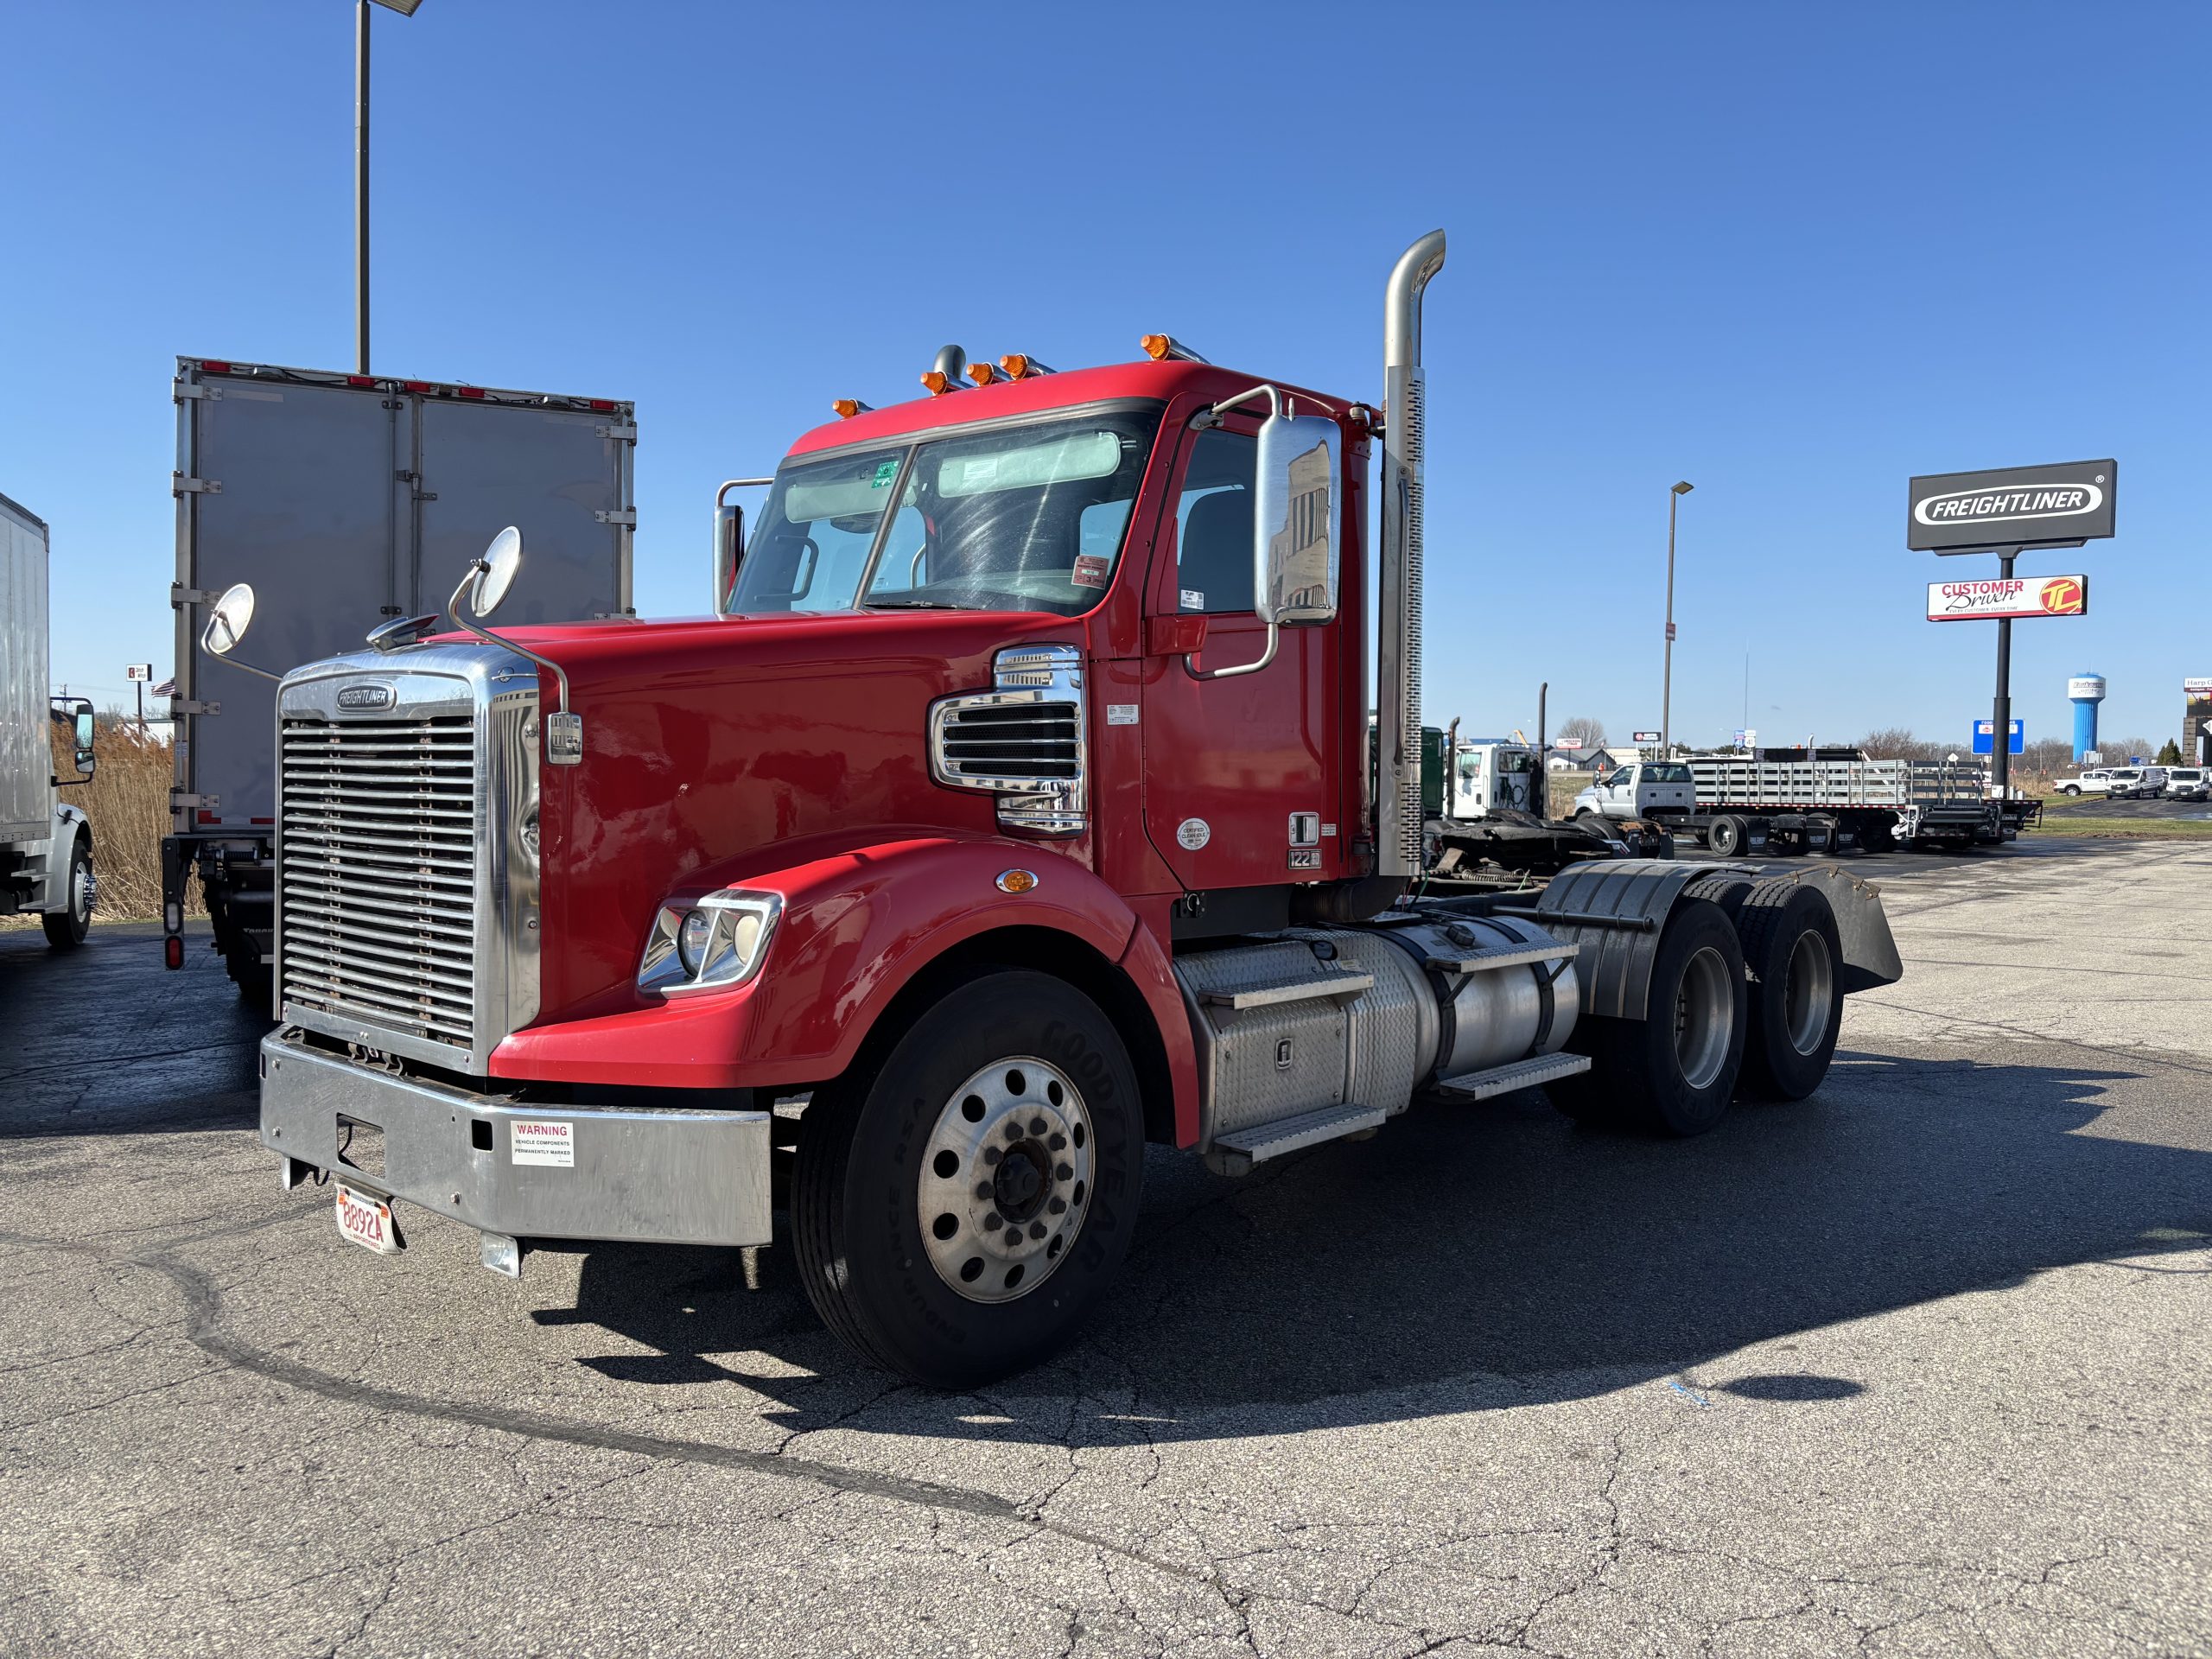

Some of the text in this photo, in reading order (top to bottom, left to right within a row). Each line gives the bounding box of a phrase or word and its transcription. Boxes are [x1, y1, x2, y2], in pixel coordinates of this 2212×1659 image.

[1932, 491, 2083, 518] FREIGHTLINER
[1942, 581, 2024, 596] CUSTOMER
[1945, 589, 2016, 612] Driven
[339, 690, 386, 704] FREIGHTLINER
[517, 1124, 568, 1136] WARNING
[893, 1096, 927, 1166] RSA
[1040, 1020, 1128, 1274] GOODYEAR
[343, 1201, 384, 1243] 8892A
[887, 1185, 968, 1344] ENDURANCE
